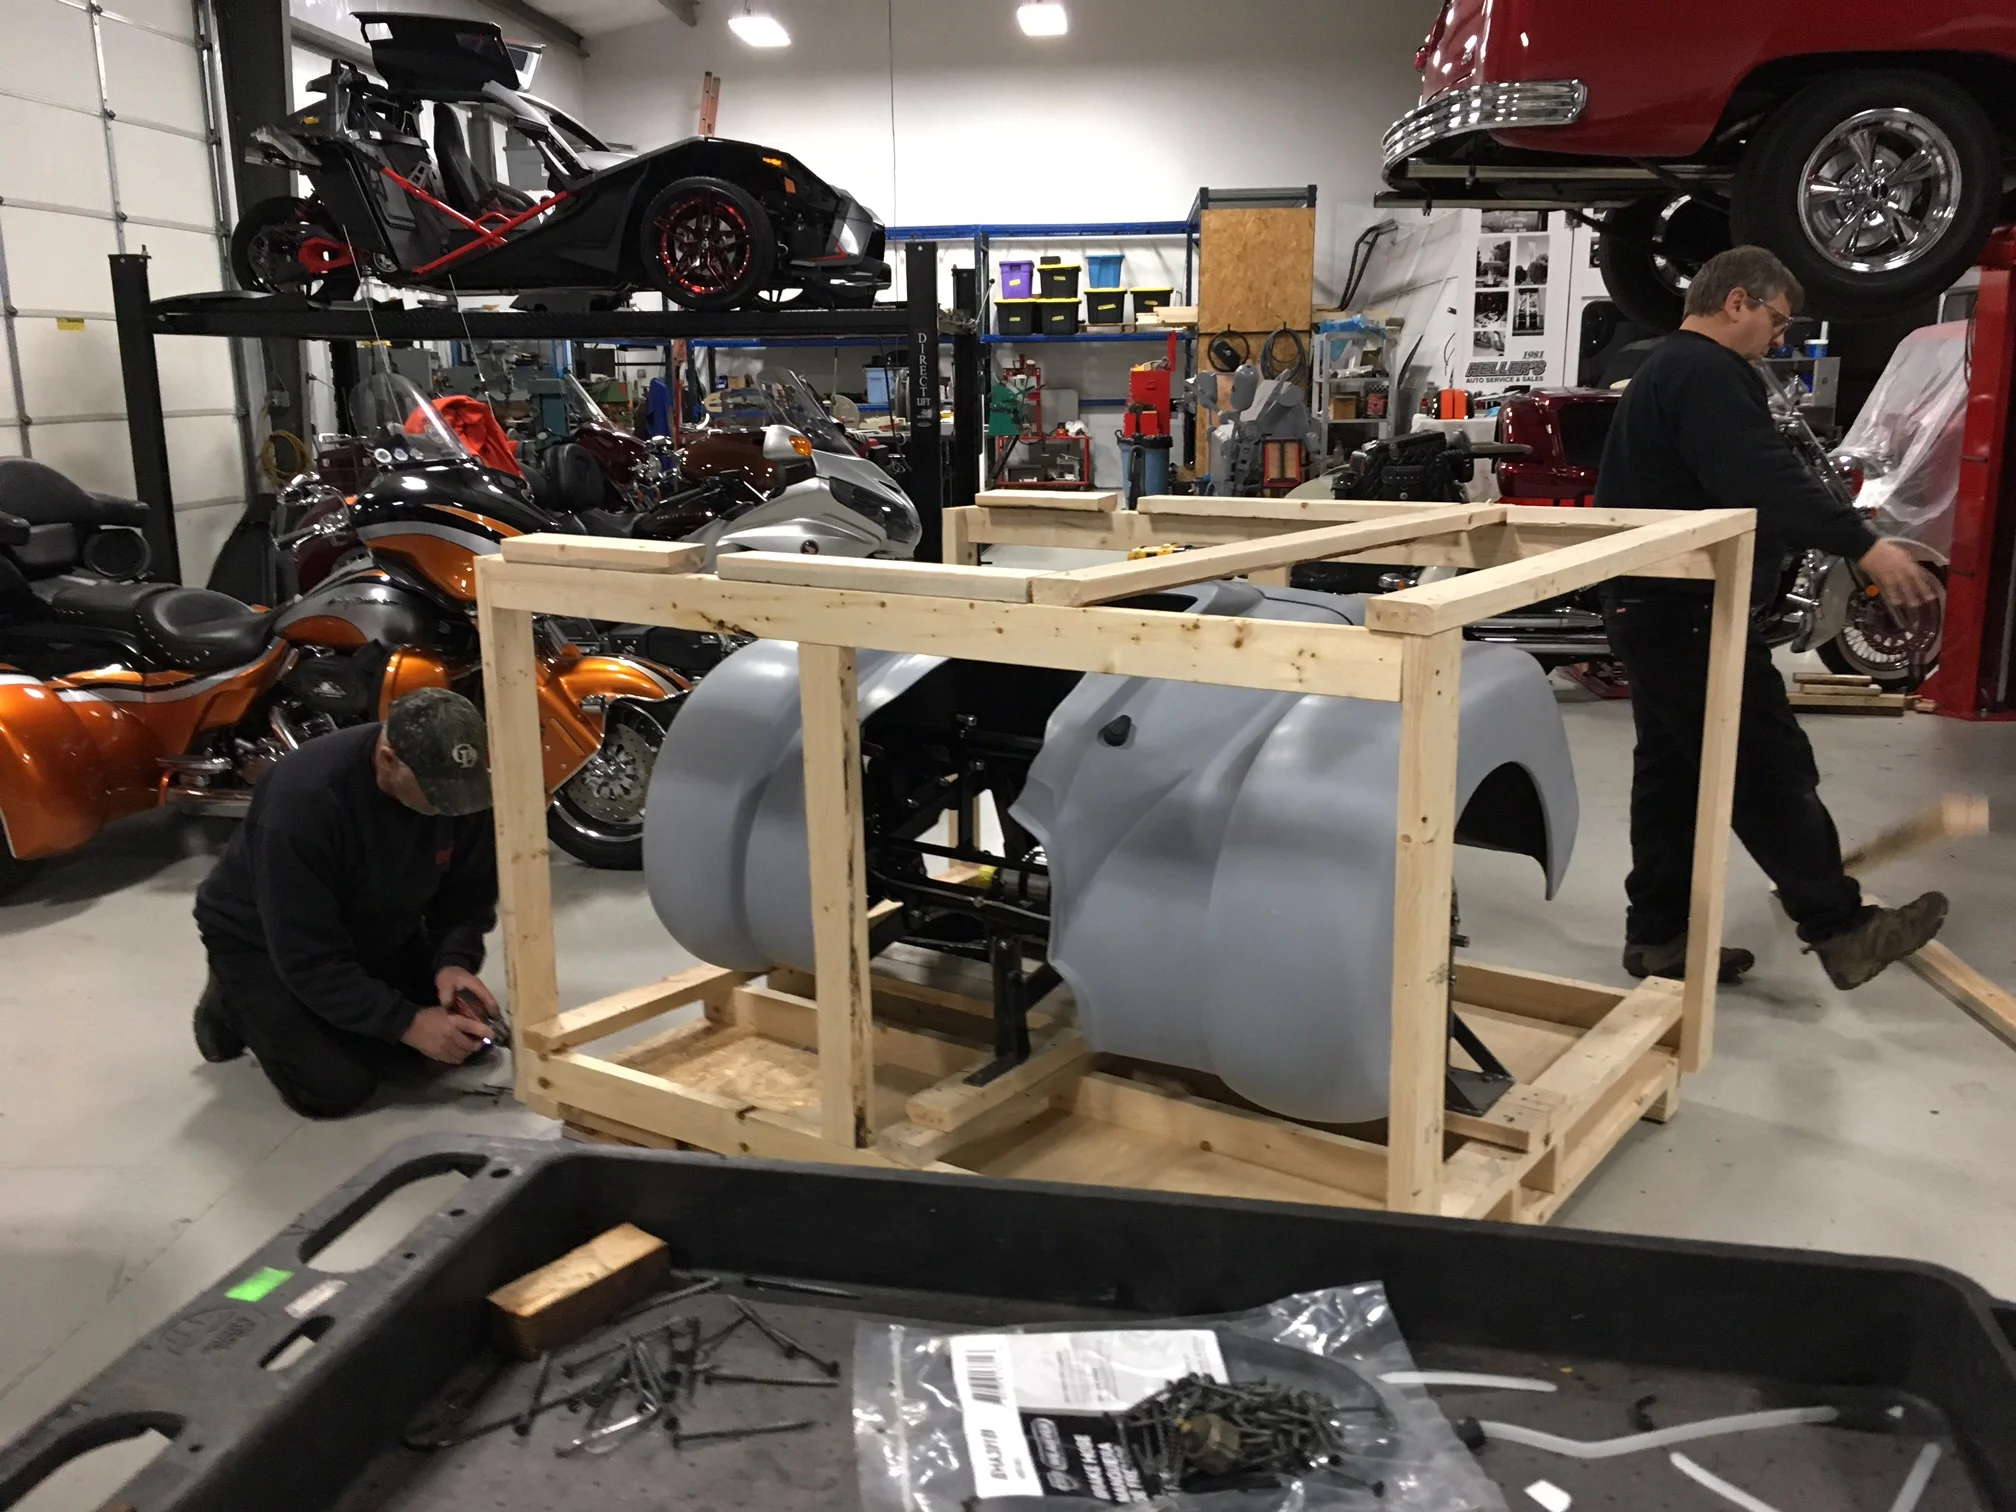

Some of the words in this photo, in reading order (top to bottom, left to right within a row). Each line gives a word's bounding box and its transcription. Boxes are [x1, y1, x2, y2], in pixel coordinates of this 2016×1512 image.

[1522, 351, 1544, 359] 1981
[918, 332, 928, 397] DIRECT
[1465, 360, 1547, 377] HELLER'S
[916, 397, 931, 406] LIFT
